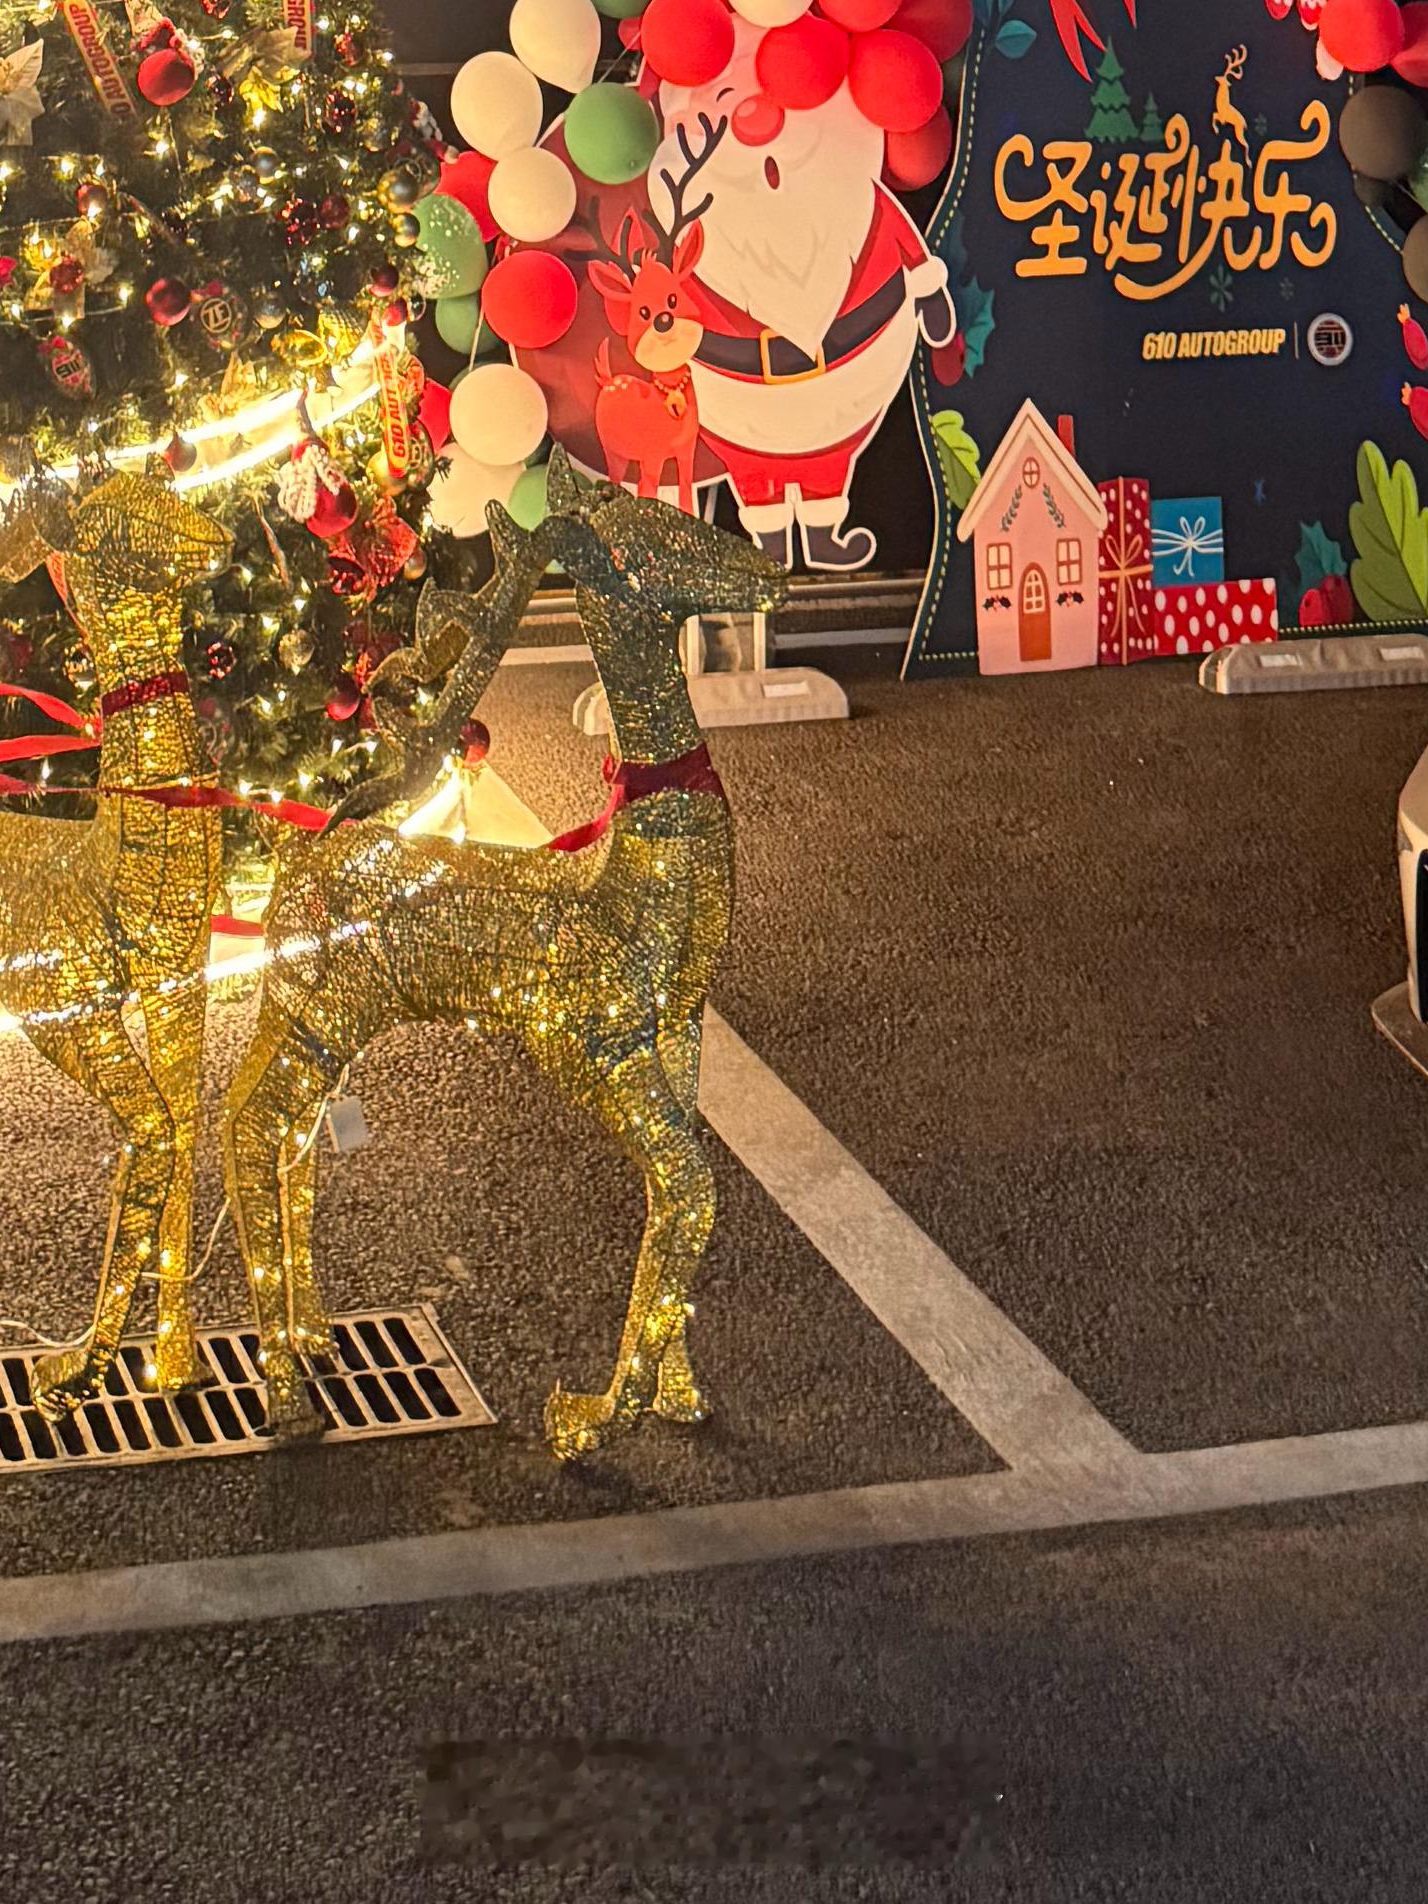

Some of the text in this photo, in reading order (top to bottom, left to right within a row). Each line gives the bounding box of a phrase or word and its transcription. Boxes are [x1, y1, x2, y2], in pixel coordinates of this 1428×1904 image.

[69, 4, 127, 99] AUTOGROUP
[994, 99, 1337, 301] 圣诞快乐
[1142, 328, 1285, 361] 610 AUTOGROUP
[391, 425, 406, 458] 610
